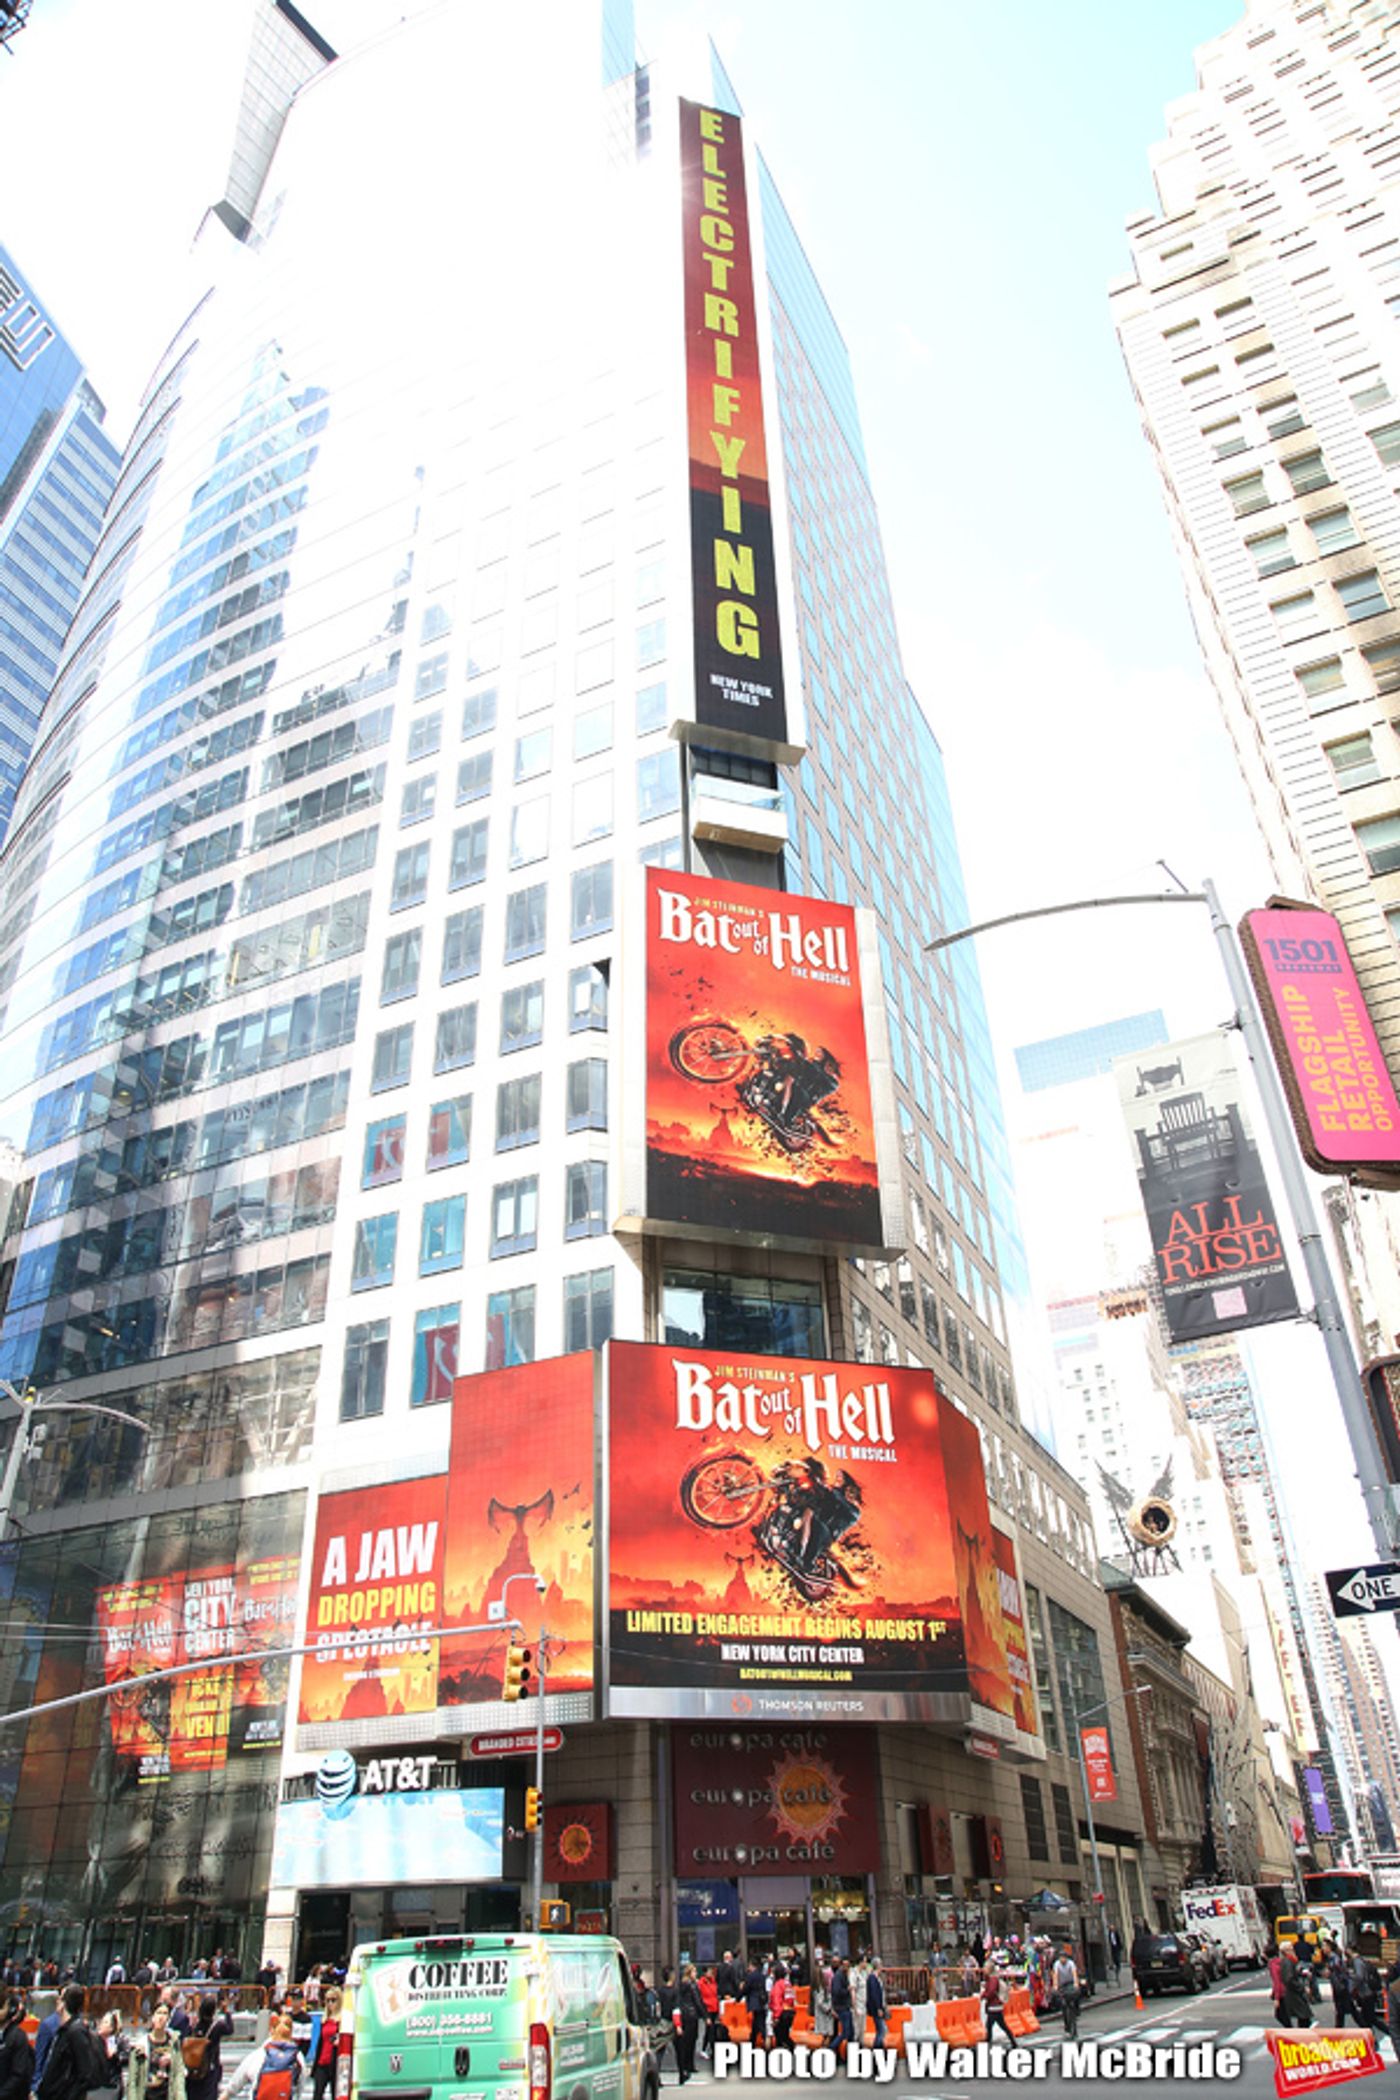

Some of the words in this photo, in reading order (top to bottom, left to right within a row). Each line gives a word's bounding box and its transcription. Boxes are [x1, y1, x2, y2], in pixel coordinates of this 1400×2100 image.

[699, 108, 761, 660] ELECTRIFYING
[710, 673, 740, 690] NEW
[740, 678, 773, 699] YORK
[657, 887, 741, 953] Bat
[733, 920, 760, 938] out
[753, 936, 769, 955] of
[768, 913, 849, 972] Hell
[1264, 938, 1338, 962] 1501
[1282, 984, 1347, 1131] FLAGSHIP
[1333, 987, 1393, 1132] OPPORTUNITY
[1323, 1029, 1374, 1131] RETAIL
[1165, 1194, 1264, 1248] ALL
[1158, 1223, 1282, 1286] RISE
[714, 1365, 734, 1378] JIM
[672, 1359, 771, 1436] Bat
[761, 1388, 792, 1415] out
[784, 1406, 802, 1434] of
[801, 1374, 894, 1451] Hell
[828, 1444, 848, 1459] THE
[850, 1446, 897, 1462] MUSICAL
[321, 1536, 346, 1587] A
[354, 1521, 438, 1583] JAW
[317, 1581, 436, 1627] DROPPING
[1351, 1577, 1396, 1600] ONE
[184, 1594, 237, 1631] CITY
[627, 1610, 692, 1634] LIMITED
[697, 1613, 801, 1638] ENGAGEMENT
[805, 1616, 861, 1639] BEGINS
[865, 1619, 924, 1641] AUGUST
[721, 1644, 750, 1661] NEW
[752, 1645, 787, 1662] YORK
[788, 1646, 816, 1663] CITY
[819, 1646, 865, 1664] CENTER
[759, 1699, 813, 1711] THOMSON
[815, 1700, 865, 1712] REUTERS
[361, 1755, 438, 1792] AT&T
[1186, 1898, 1238, 1920] FedEx
[409, 1960, 508, 1989] COFFEE
